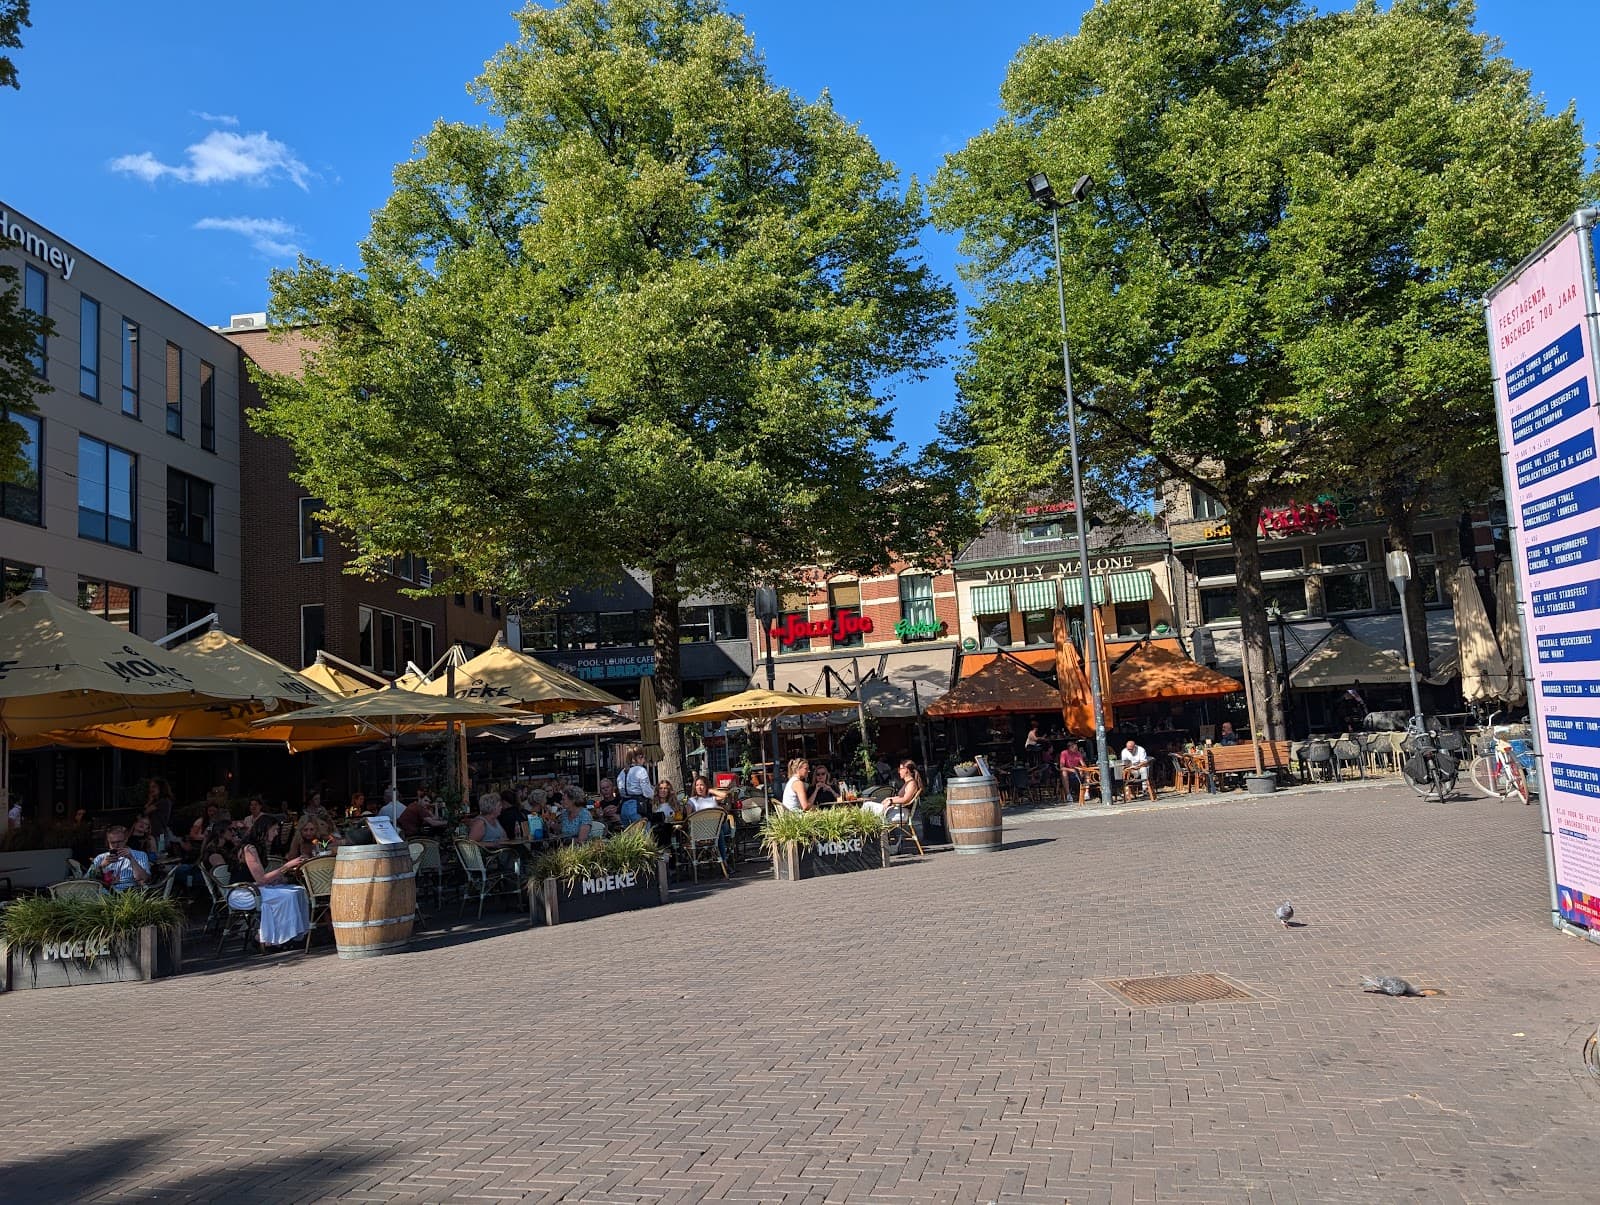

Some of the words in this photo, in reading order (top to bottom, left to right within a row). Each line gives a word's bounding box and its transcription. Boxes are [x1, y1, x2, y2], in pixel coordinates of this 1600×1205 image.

[1498, 285, 1547, 331] FEESTAGENDA
[1500, 315, 1535, 350] ENSCHEDE
[1539, 303, 1553, 323] 700
[1558, 284, 1577, 309] JAAR
[1542, 343, 1559, 362] SOUNDS
[1554, 350, 1568, 368] MARKT
[985, 565, 1044, 582] MOLLY
[1058, 555, 1134, 573] MALONE
[578, 656, 635, 667] POOL-LOUNGE
[817, 838, 863, 856] MOEKE
[582, 871, 635, 895] MOEKE
